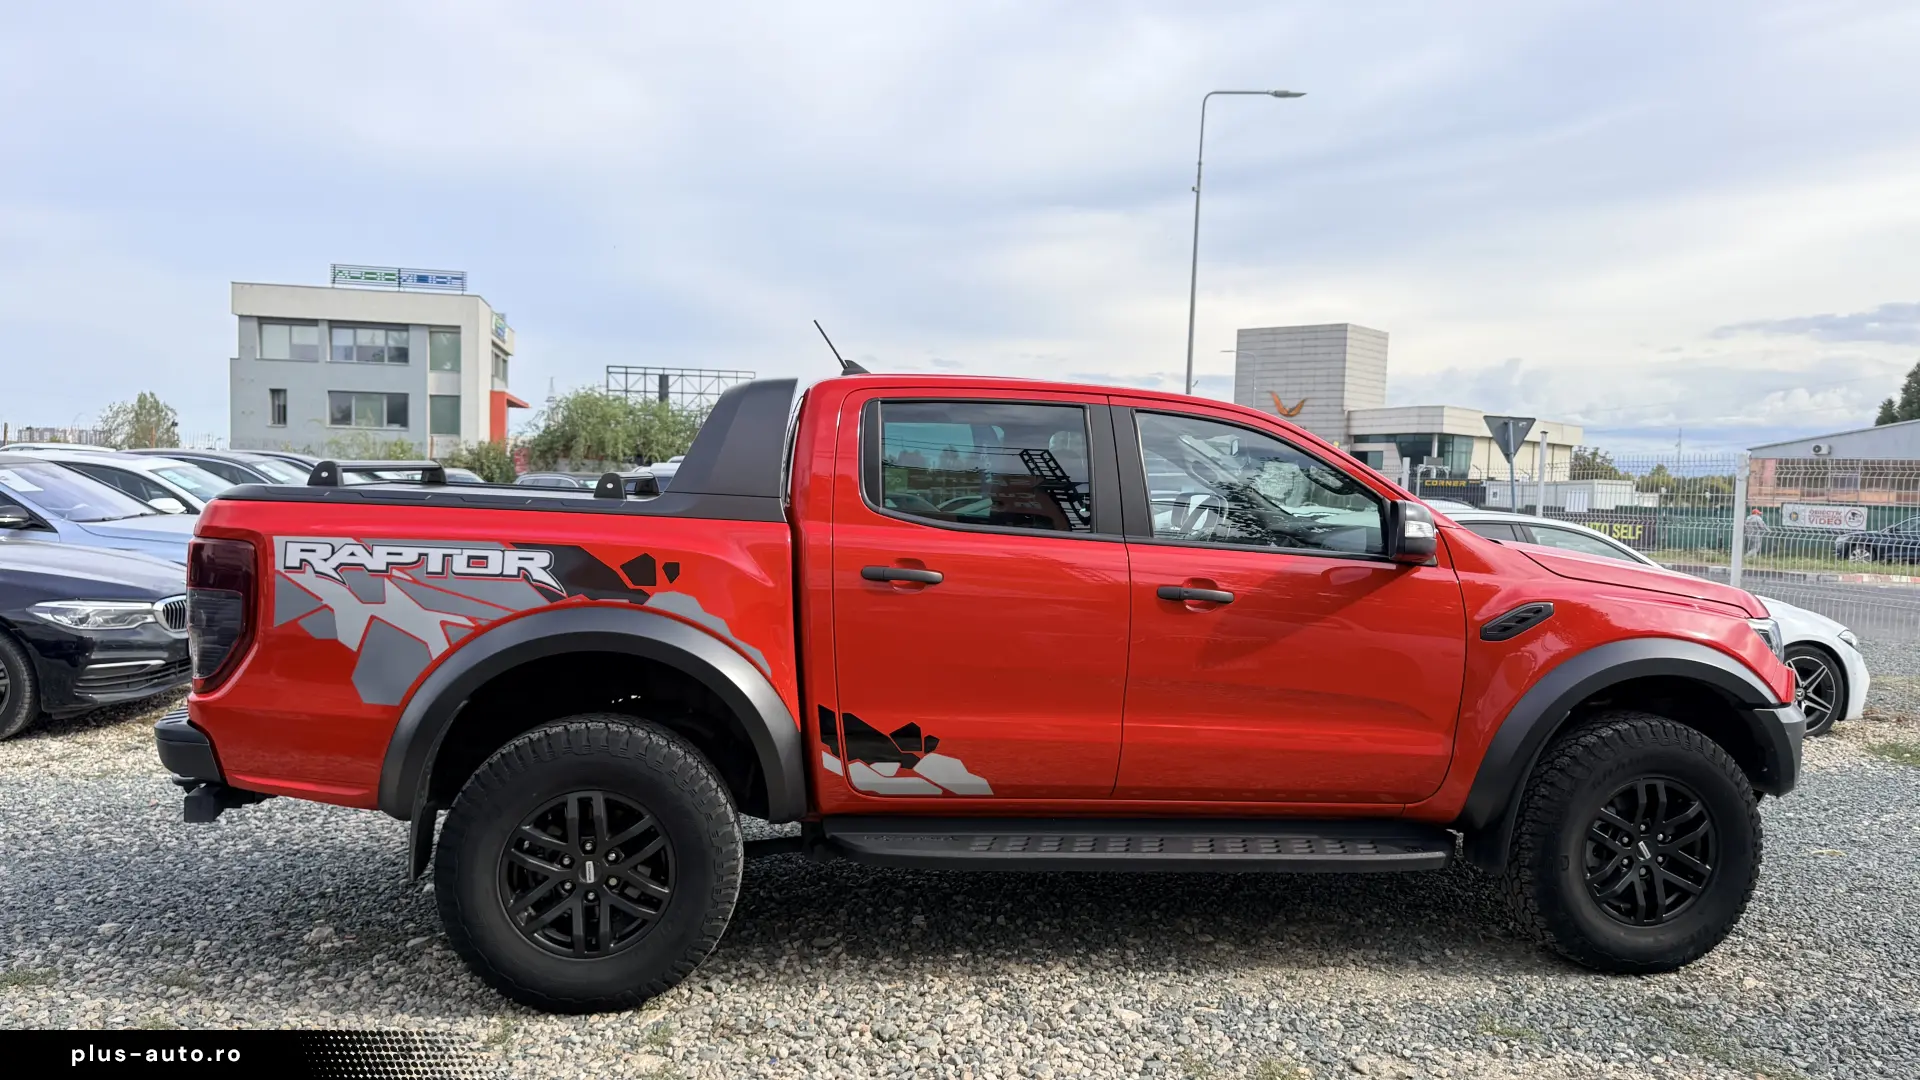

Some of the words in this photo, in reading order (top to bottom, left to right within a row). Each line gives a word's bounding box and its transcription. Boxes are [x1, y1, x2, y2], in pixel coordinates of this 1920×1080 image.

[1808, 516, 1842, 525] VIDEO
[1612, 523, 1643, 540] SELF
[284, 541, 566, 596] RAPTOR
